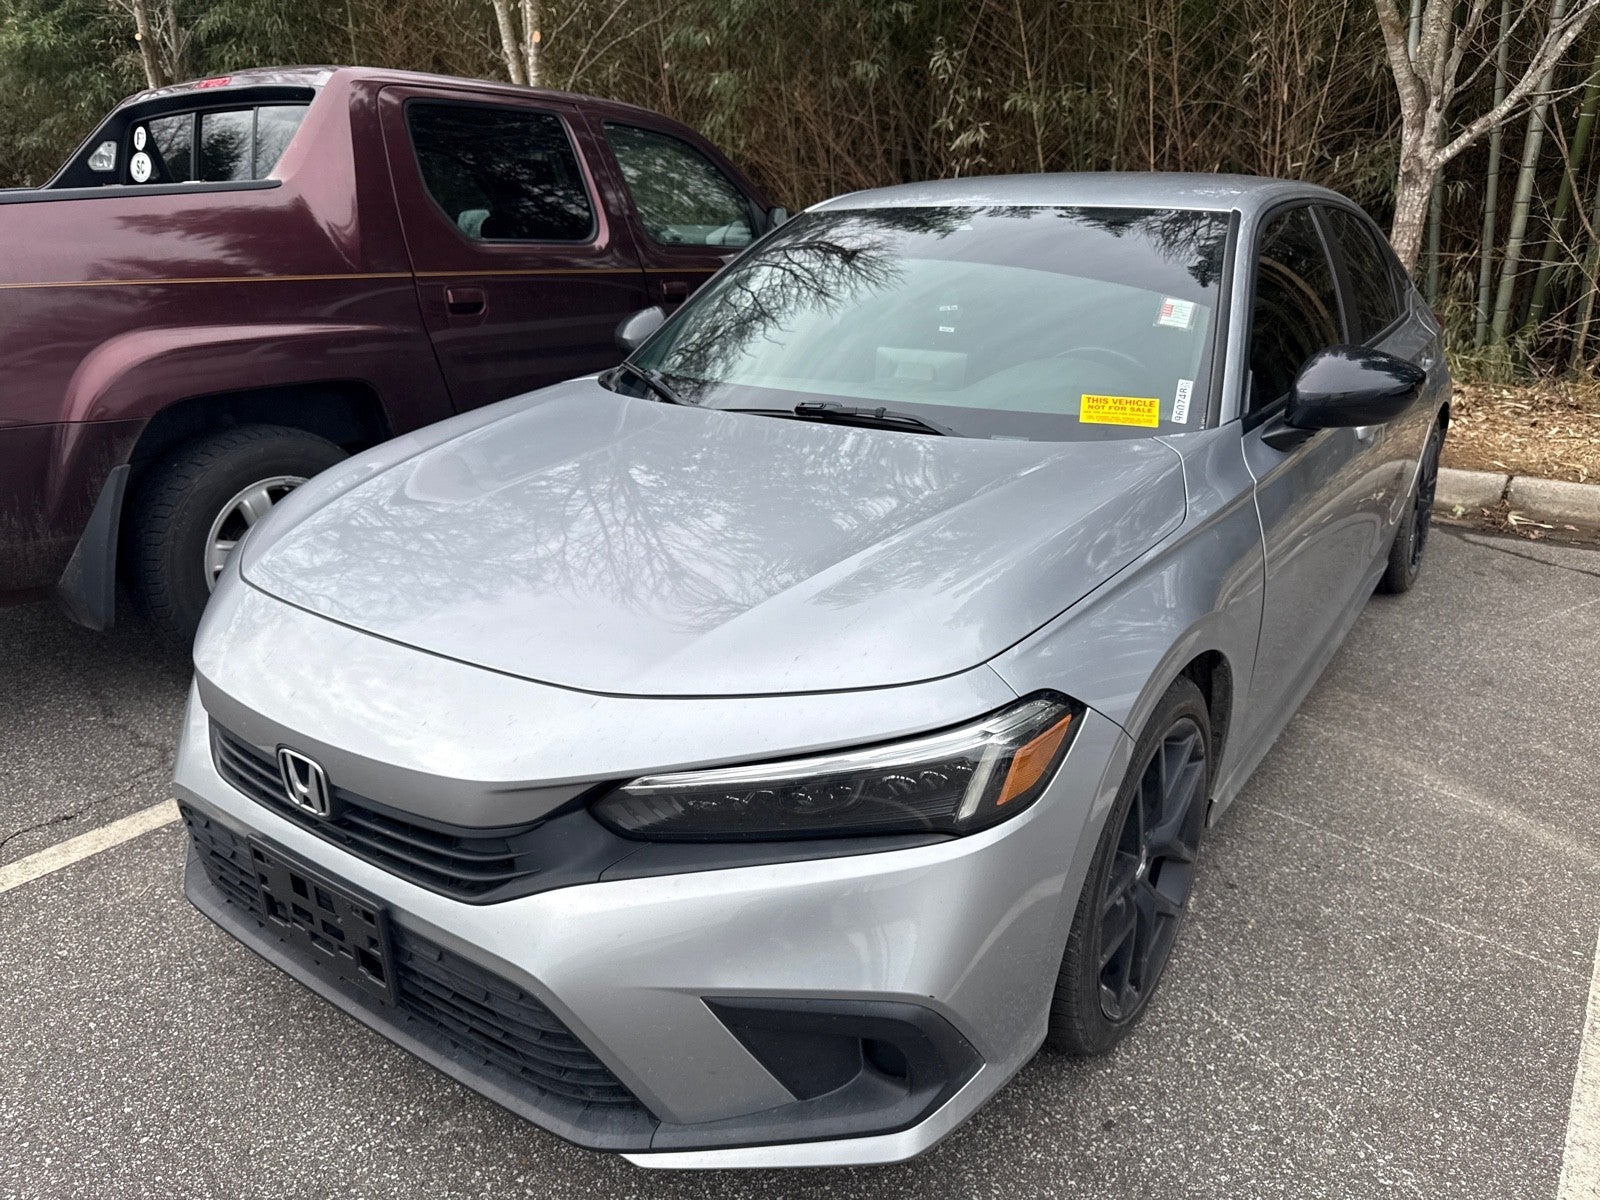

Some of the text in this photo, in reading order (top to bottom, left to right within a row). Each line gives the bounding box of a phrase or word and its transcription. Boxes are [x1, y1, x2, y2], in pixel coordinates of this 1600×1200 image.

[136, 160, 145, 175] SC
[1086, 396, 1156, 408] THIS VEHICLE
